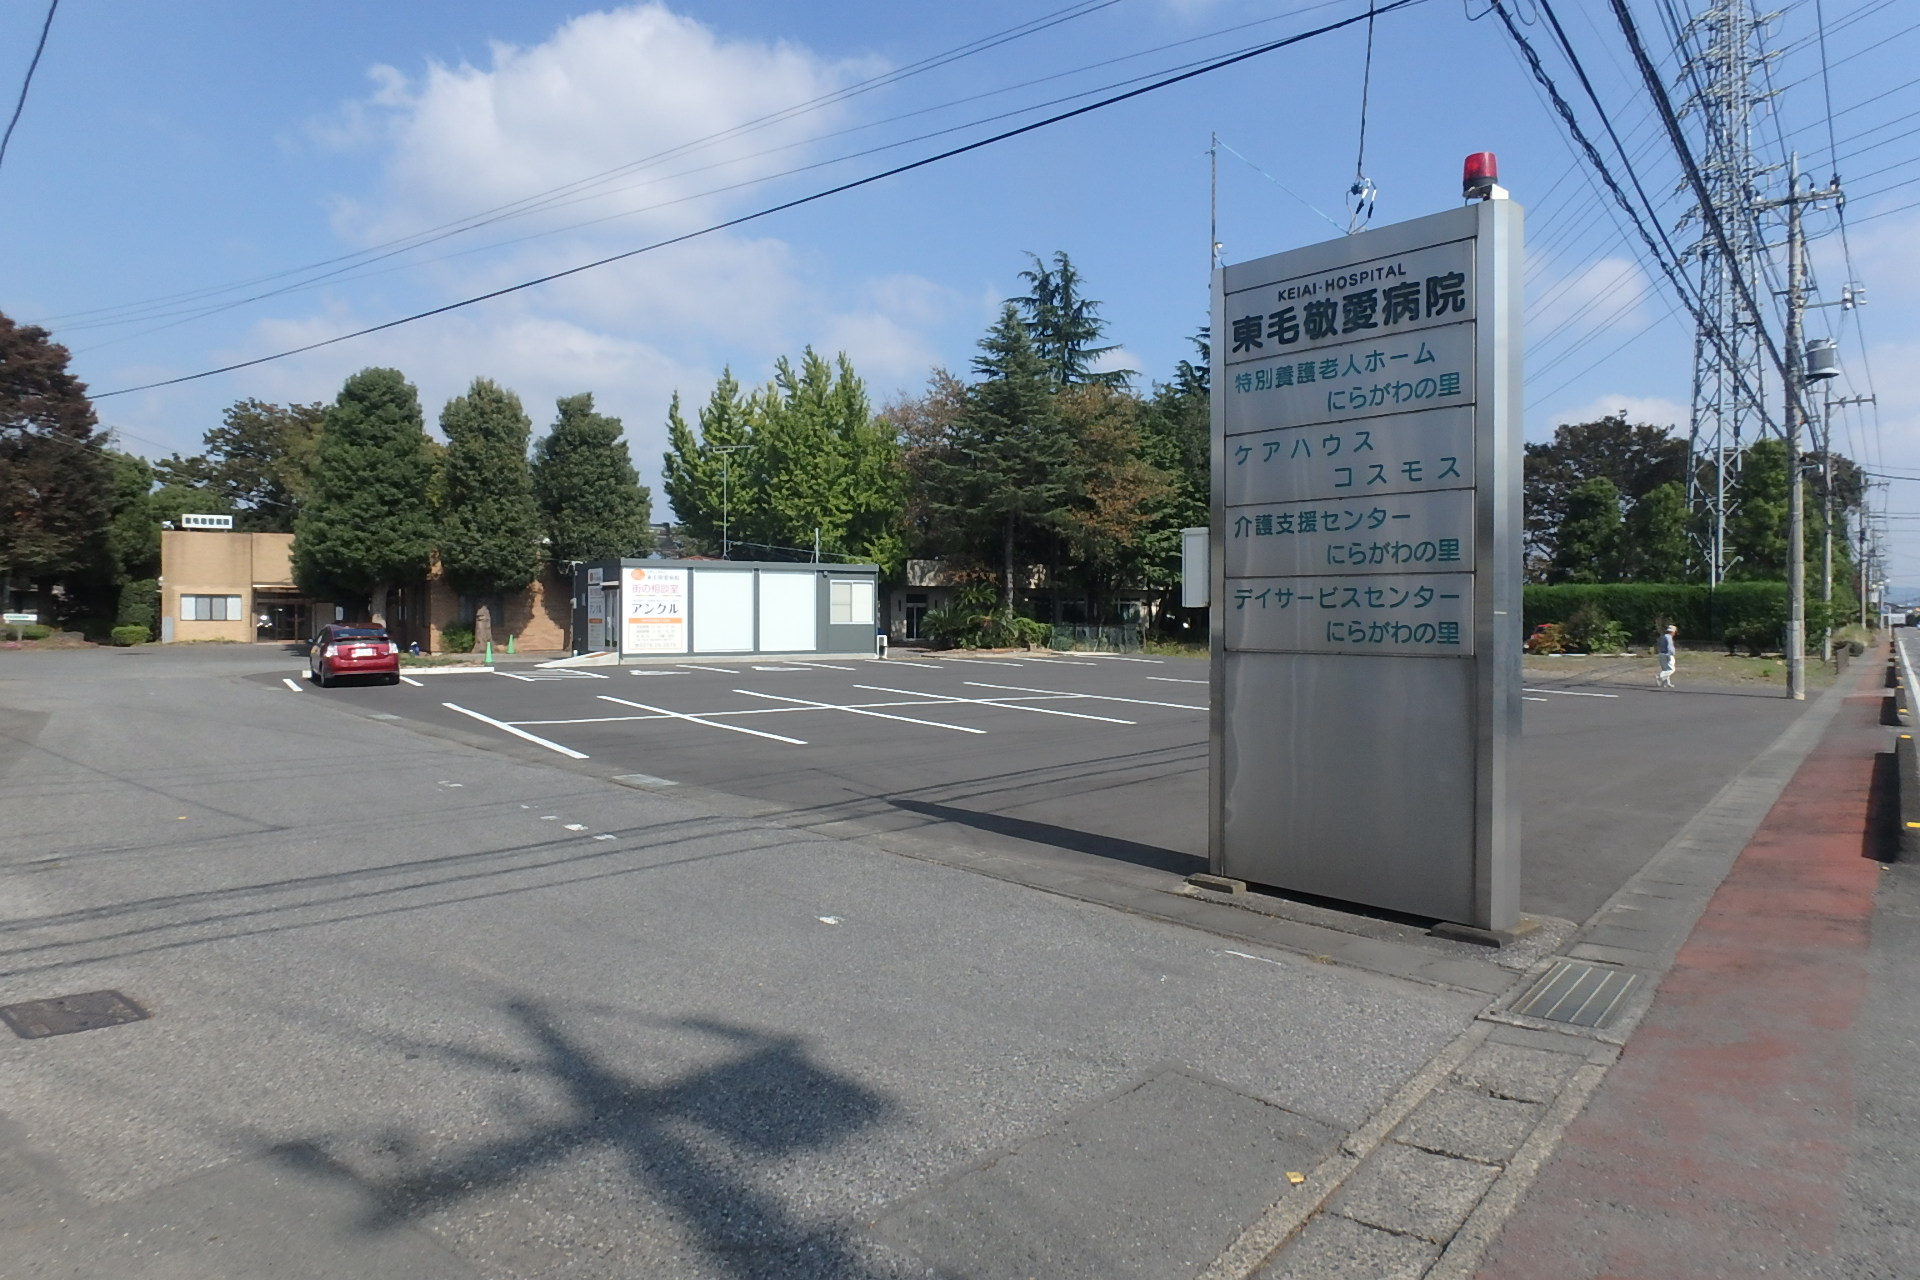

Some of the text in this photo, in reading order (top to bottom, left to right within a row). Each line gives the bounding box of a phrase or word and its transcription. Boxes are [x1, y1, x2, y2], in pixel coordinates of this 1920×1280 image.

[1231, 271, 1466, 354] 東毛敬愛病院
[1235, 342, 1436, 394] 特別養護老人ホーム
[1327, 371, 1462, 412] にらがわの里
[1235, 431, 1374, 466] ケアハウス
[1334, 456, 1461, 488] コスモス
[1234, 507, 1411, 539] 介護支援センター
[1327, 538, 1461, 565] にらがわの里
[632, 603, 679, 615] アンクル
[1234, 585, 1460, 610] デイサービスセンター
[1327, 621, 1461, 645] にらがわの里
